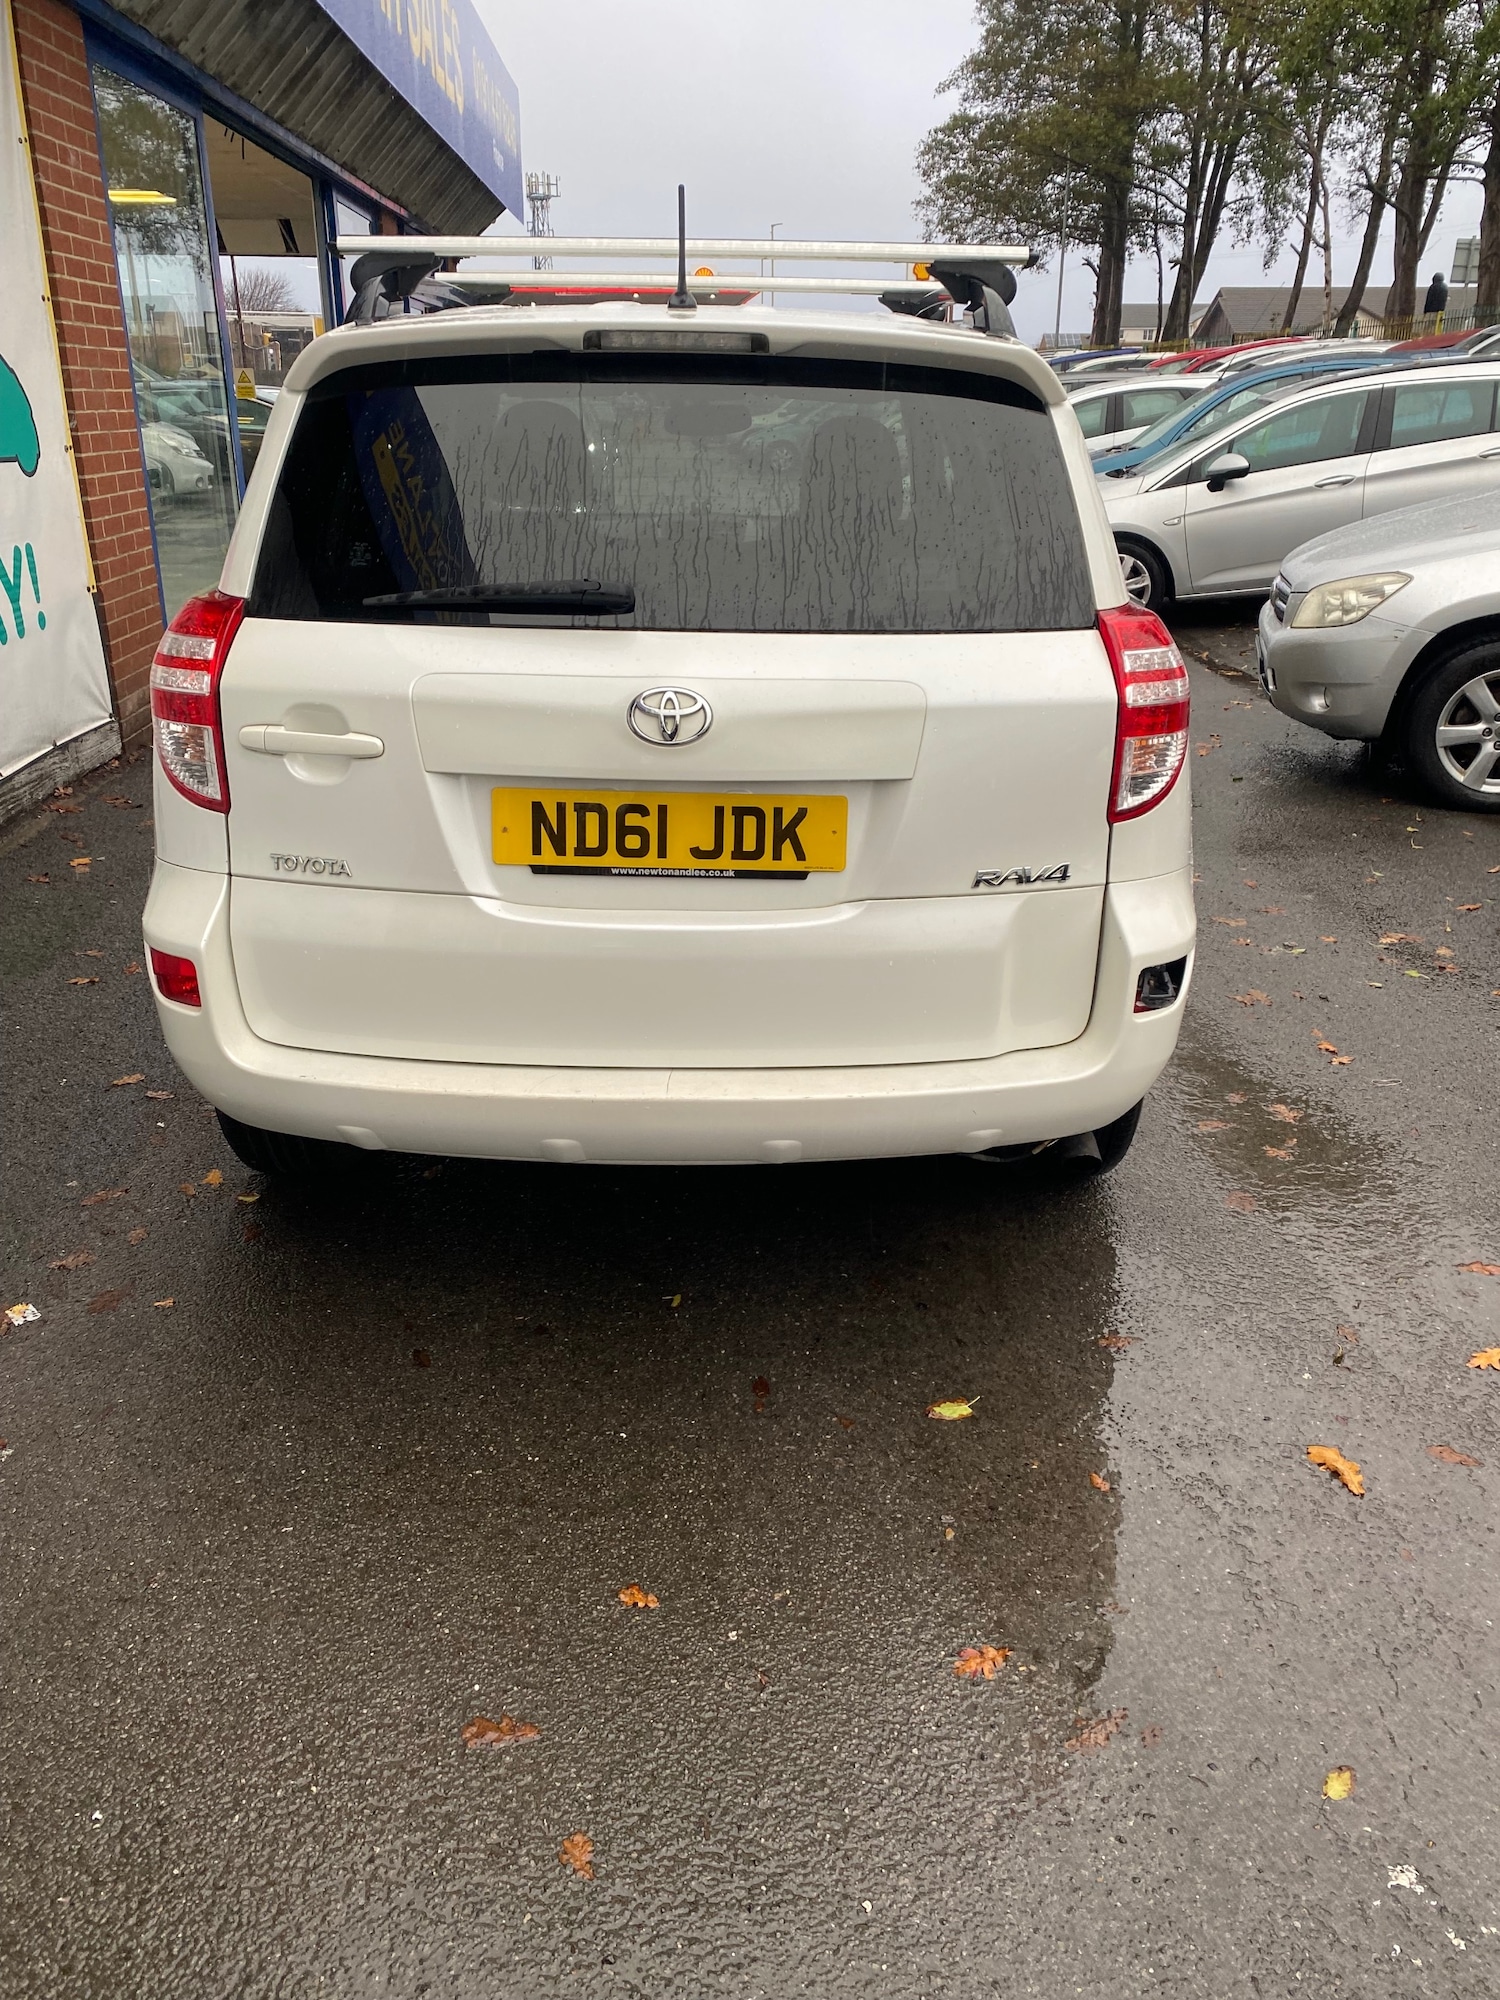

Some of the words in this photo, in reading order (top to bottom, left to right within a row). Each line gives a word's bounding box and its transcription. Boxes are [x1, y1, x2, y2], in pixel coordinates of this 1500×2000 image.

[0, 542, 46, 645] Y!
[531, 801, 668, 859] ND61
[689, 805, 808, 862] JDK
[270, 853, 352, 877] TOYOTA
[610, 867, 736, 878] www.newtonandlee.co.uk
[971, 862, 1072, 888] RAV4
